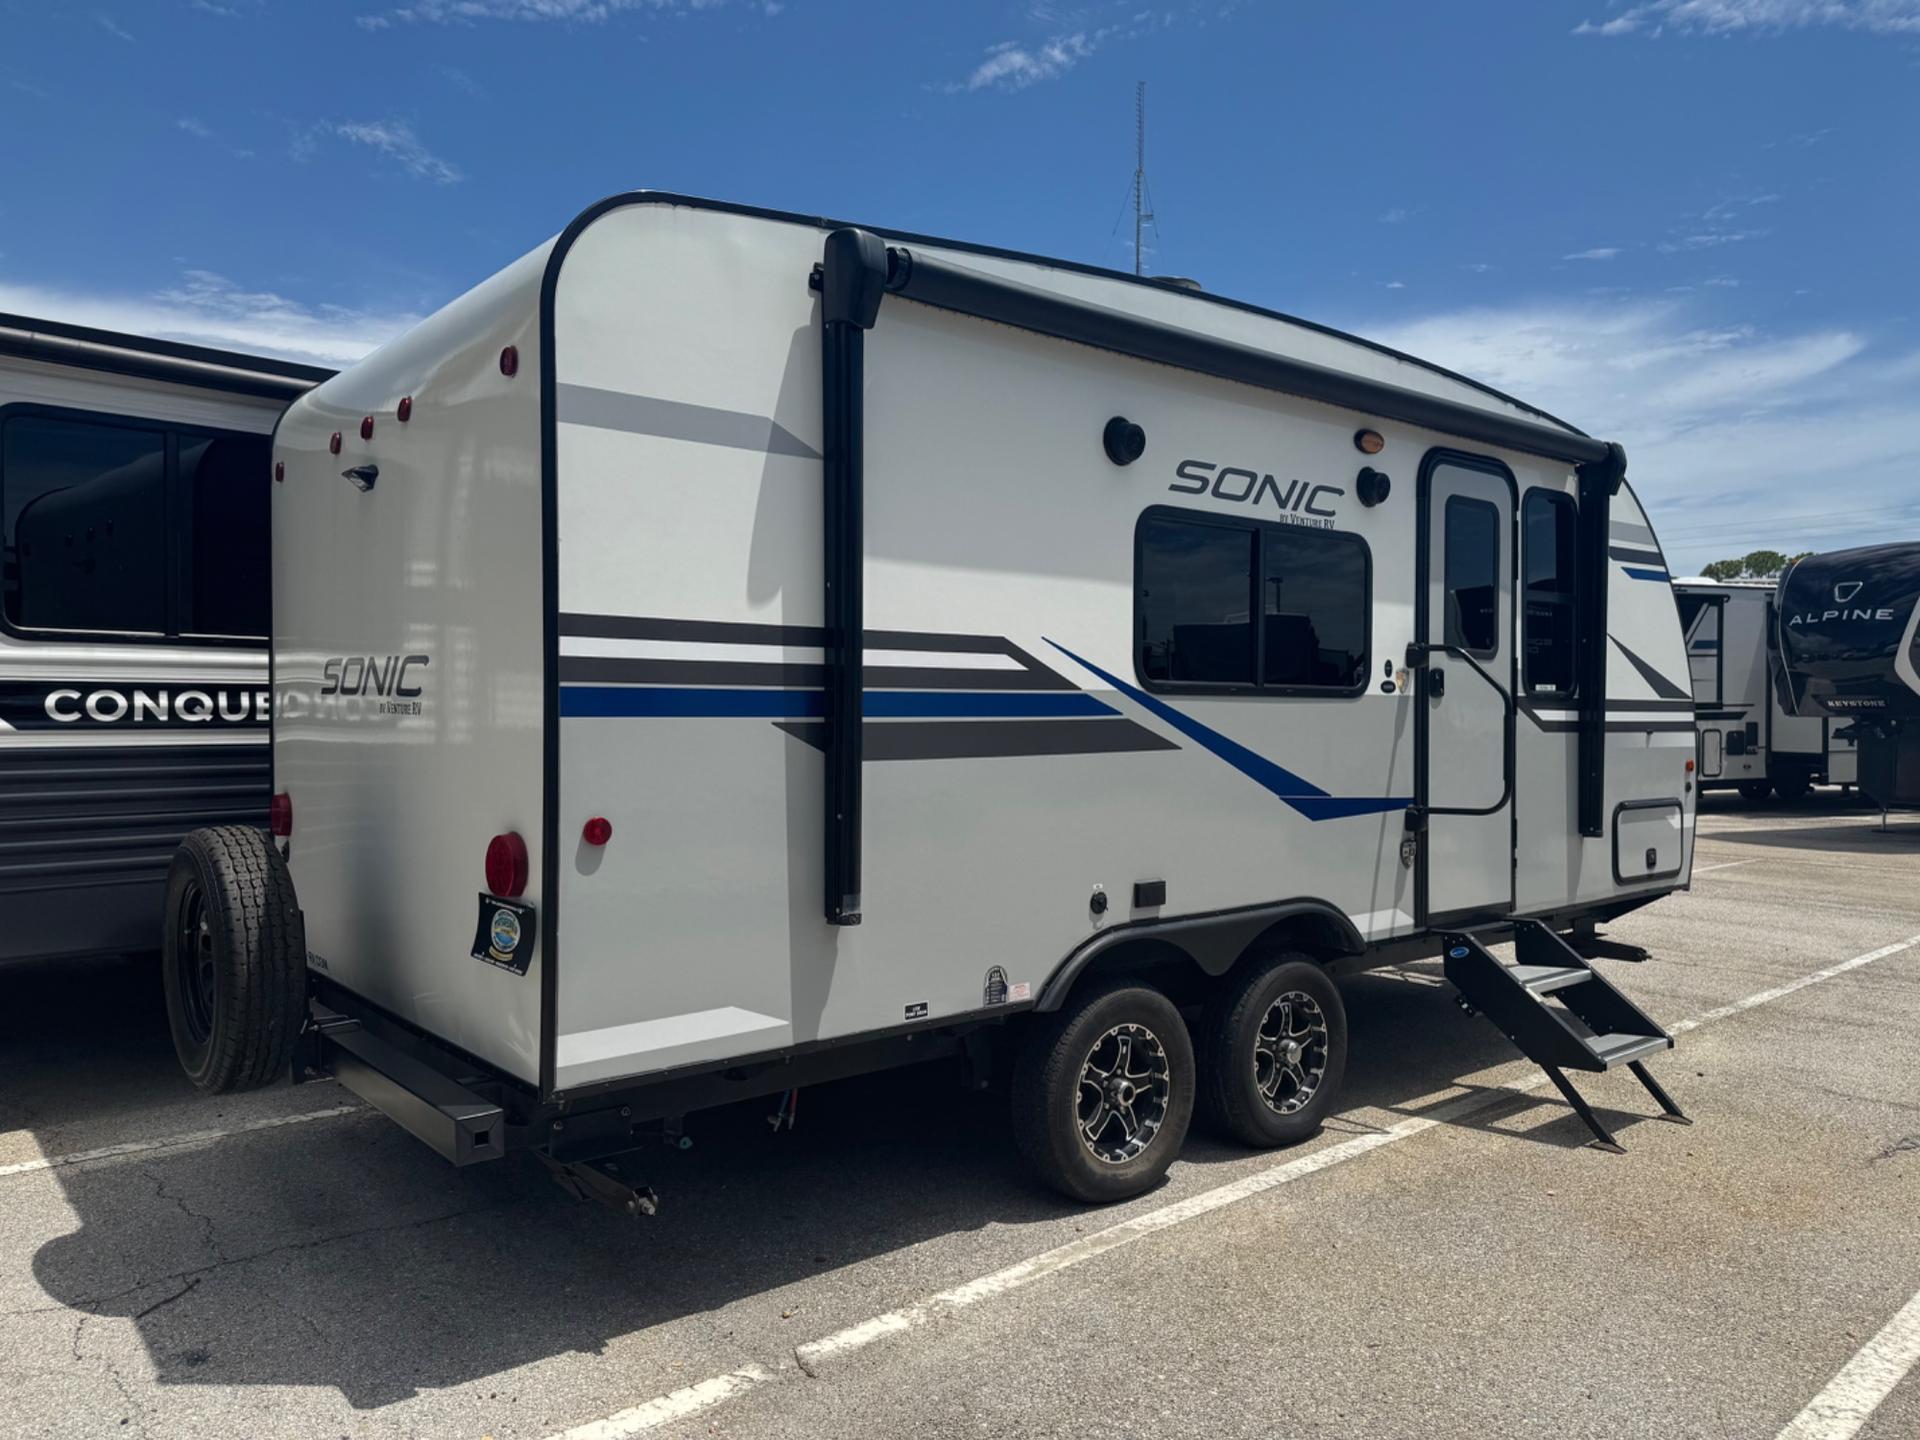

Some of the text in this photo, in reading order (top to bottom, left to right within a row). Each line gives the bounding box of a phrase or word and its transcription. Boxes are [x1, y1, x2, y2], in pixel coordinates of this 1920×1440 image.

[1168, 459, 1345, 517] SONIC
[1323, 518, 1335, 530] RV
[1789, 608, 1894, 626] ALPINE
[321, 655, 430, 697] SONIC
